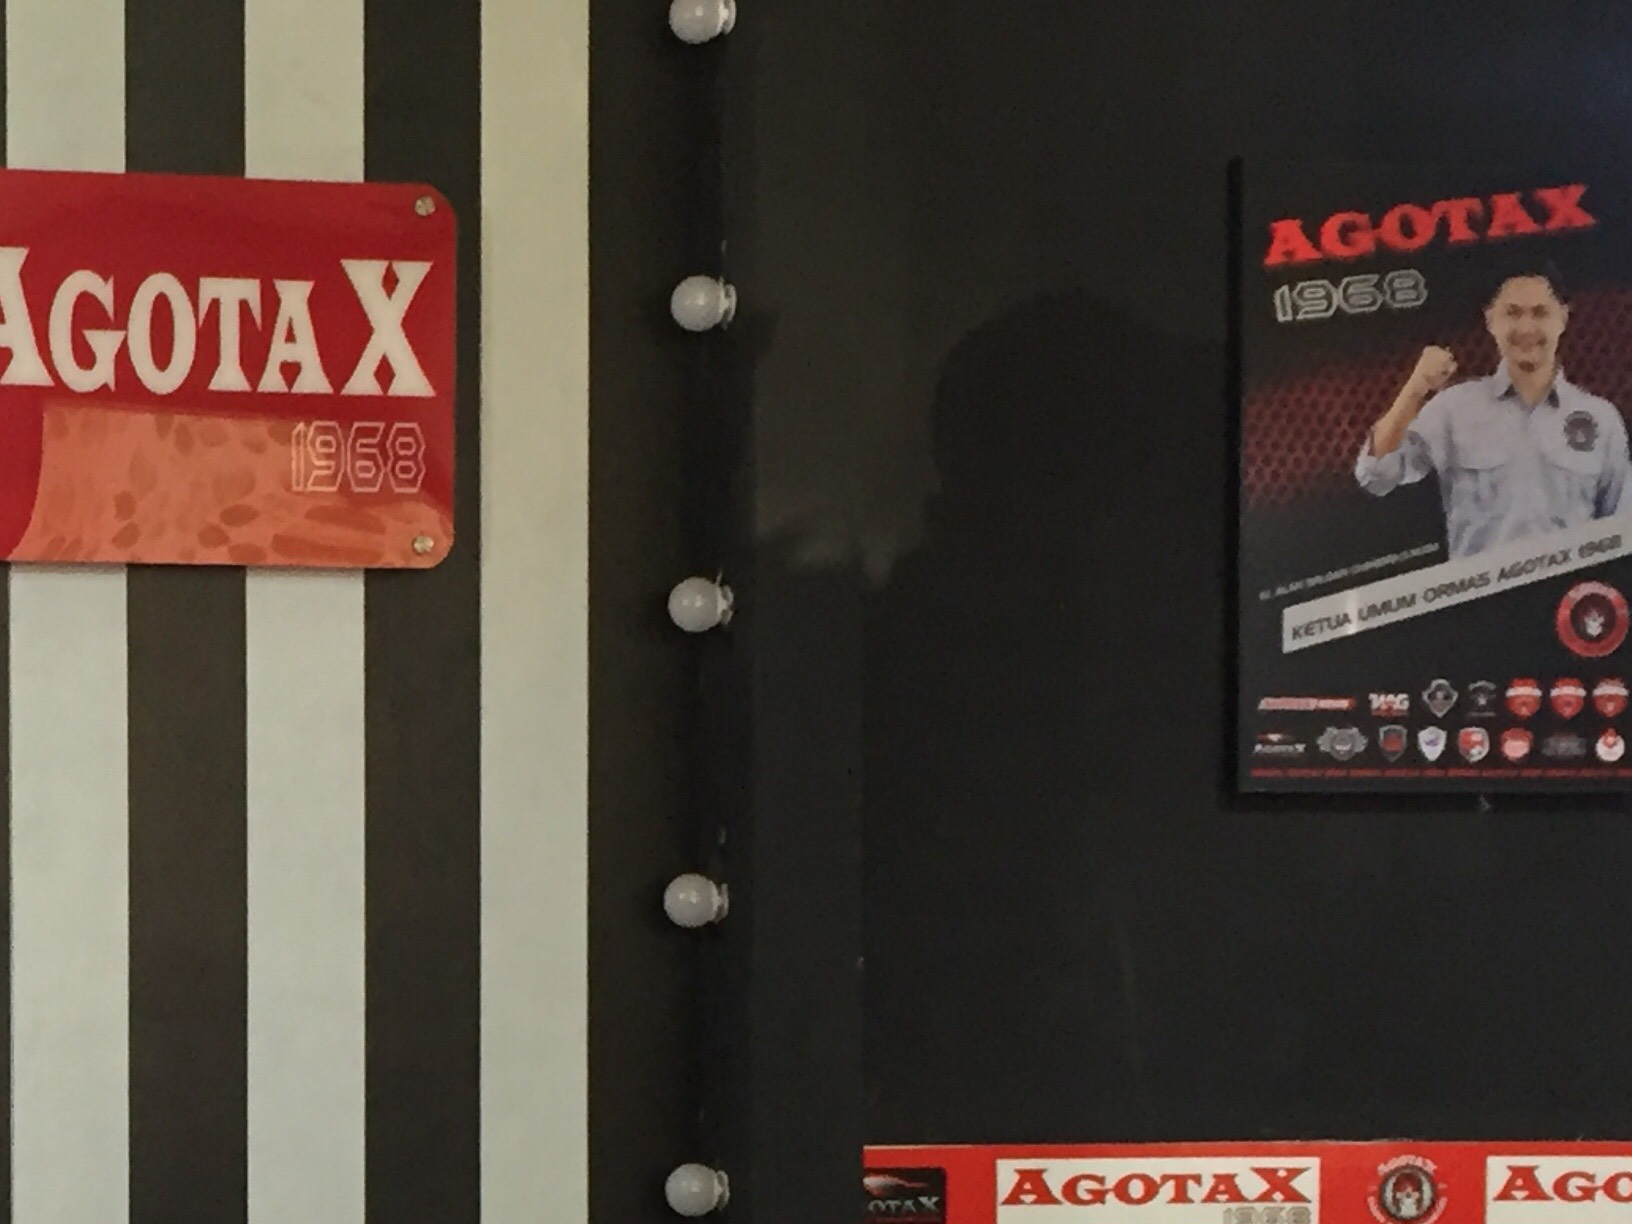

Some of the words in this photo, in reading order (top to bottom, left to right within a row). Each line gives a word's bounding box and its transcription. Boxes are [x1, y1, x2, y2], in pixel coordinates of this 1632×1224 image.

[1263, 182, 1598, 267] AGOTAX
[1273, 269, 1428, 323] 1968
[291, 421, 426, 493] 1968
[1291, 612, 1352, 641] KETUA
[1357, 593, 1417, 621] UMUM
[1496, 548, 1573, 583] AGOTAX
[1000, 1166, 1313, 1206] AGOTAX
